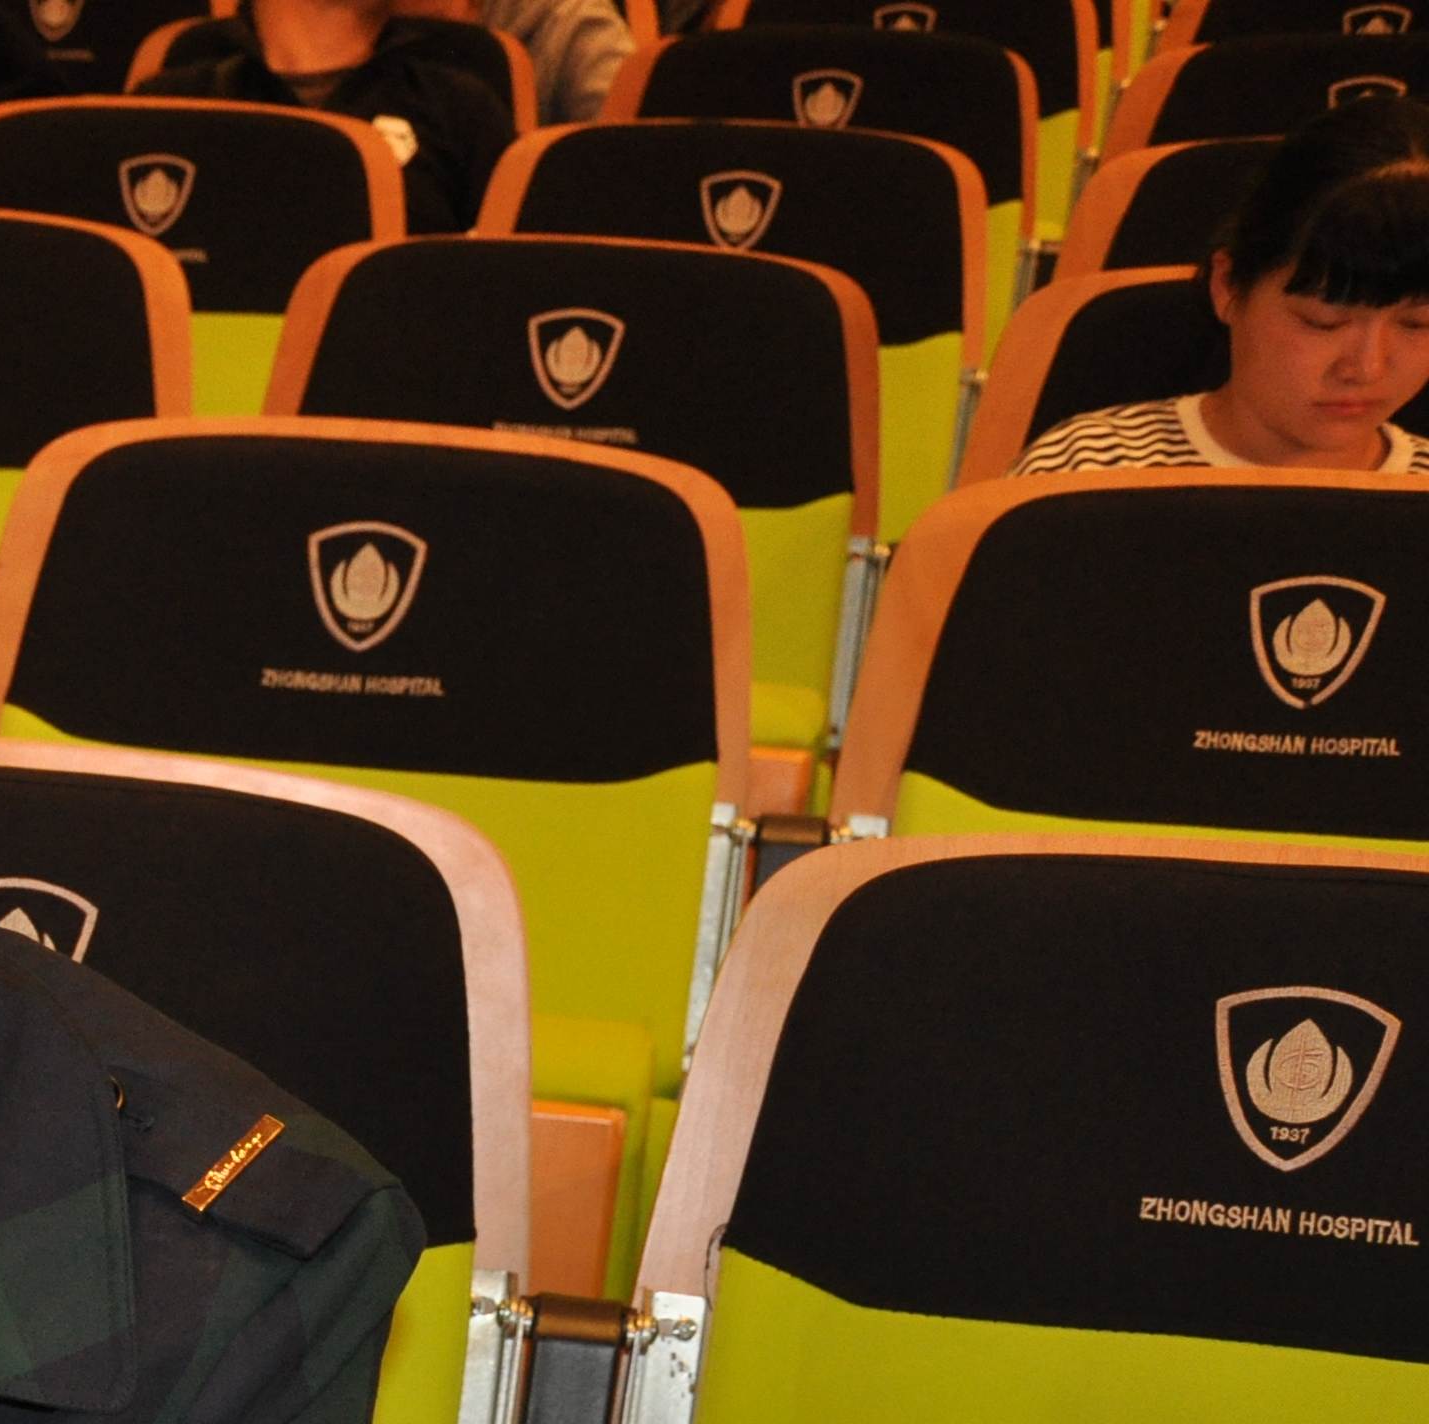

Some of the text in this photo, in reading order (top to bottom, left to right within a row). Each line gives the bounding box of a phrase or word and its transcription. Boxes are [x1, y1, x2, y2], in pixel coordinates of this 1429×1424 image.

[261, 668, 445, 696] ZHONGSHAN HOSPITAL
[1193, 729, 1401, 758] ZHONGSHAN HOSPITAL
[1269, 1126, 1311, 1145] 1937
[1140, 1196, 1420, 1247] ZHONGSHAN HOSPITAL
